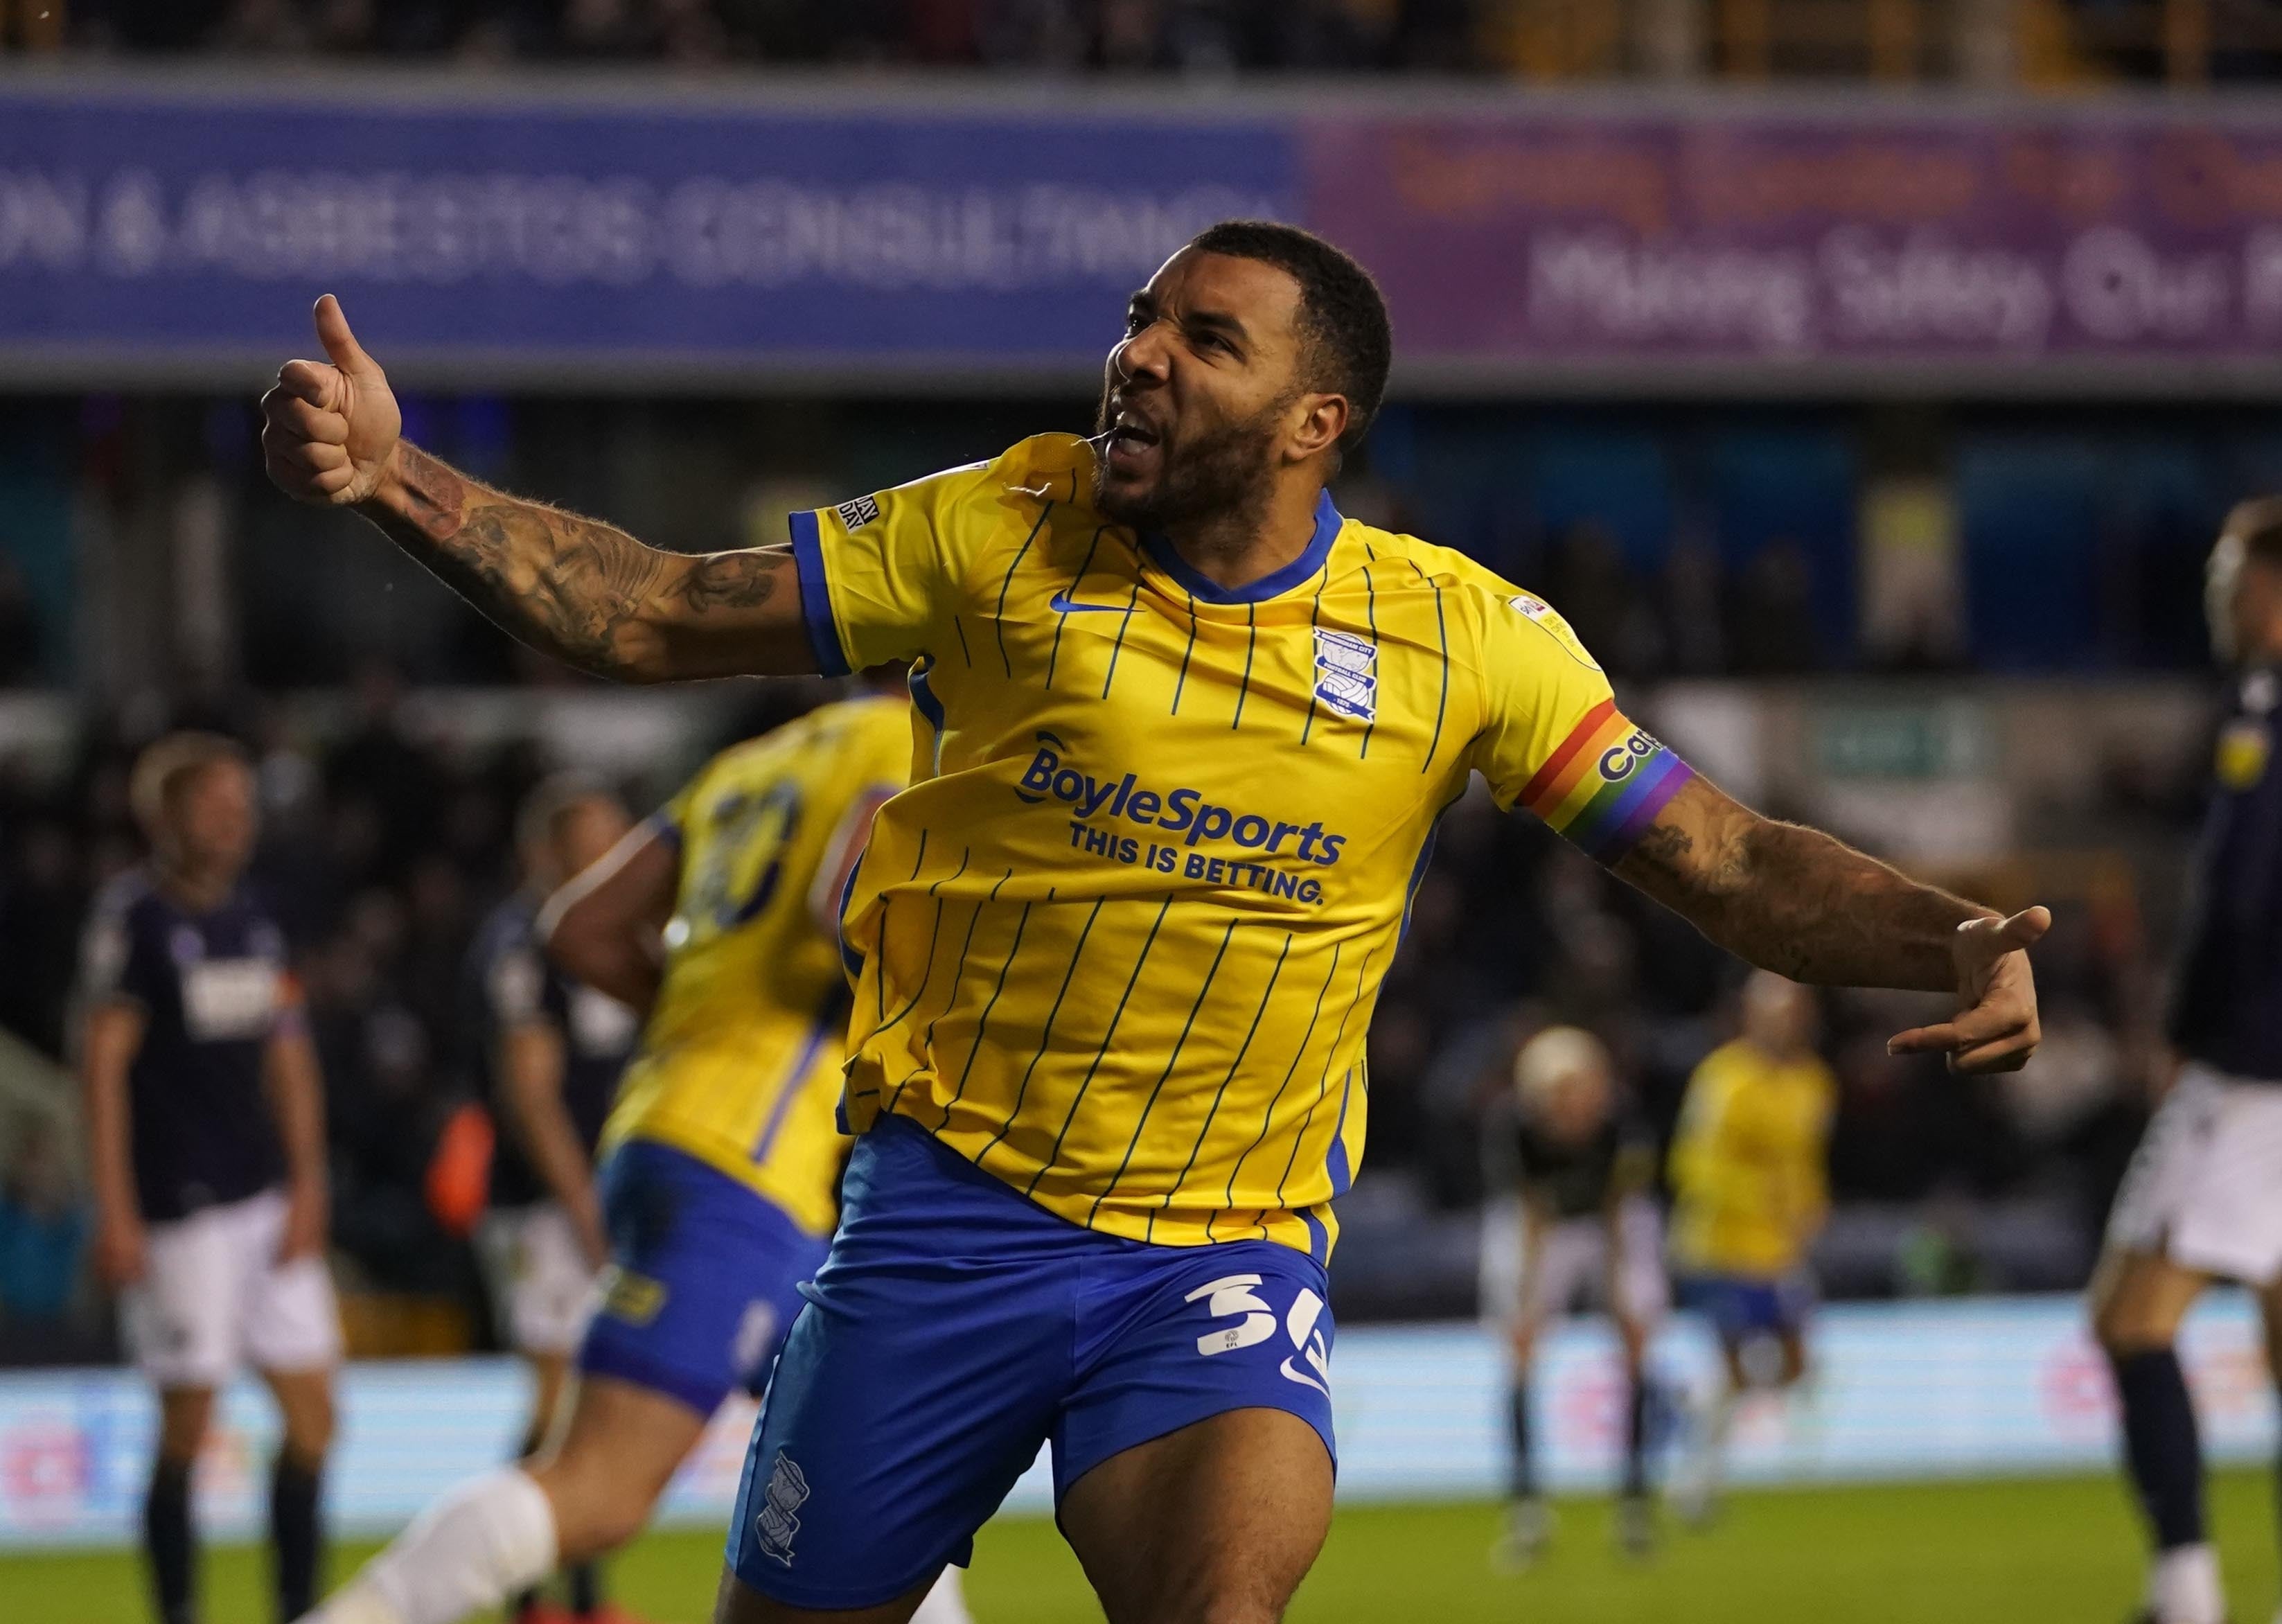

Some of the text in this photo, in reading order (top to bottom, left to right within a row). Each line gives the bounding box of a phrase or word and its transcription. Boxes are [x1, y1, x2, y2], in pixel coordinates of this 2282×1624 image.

[839, 502, 863, 529] DAY
[1018, 746, 1347, 866] BoyleSports
[1069, 820, 1324, 906] THIS IS BETTING.
